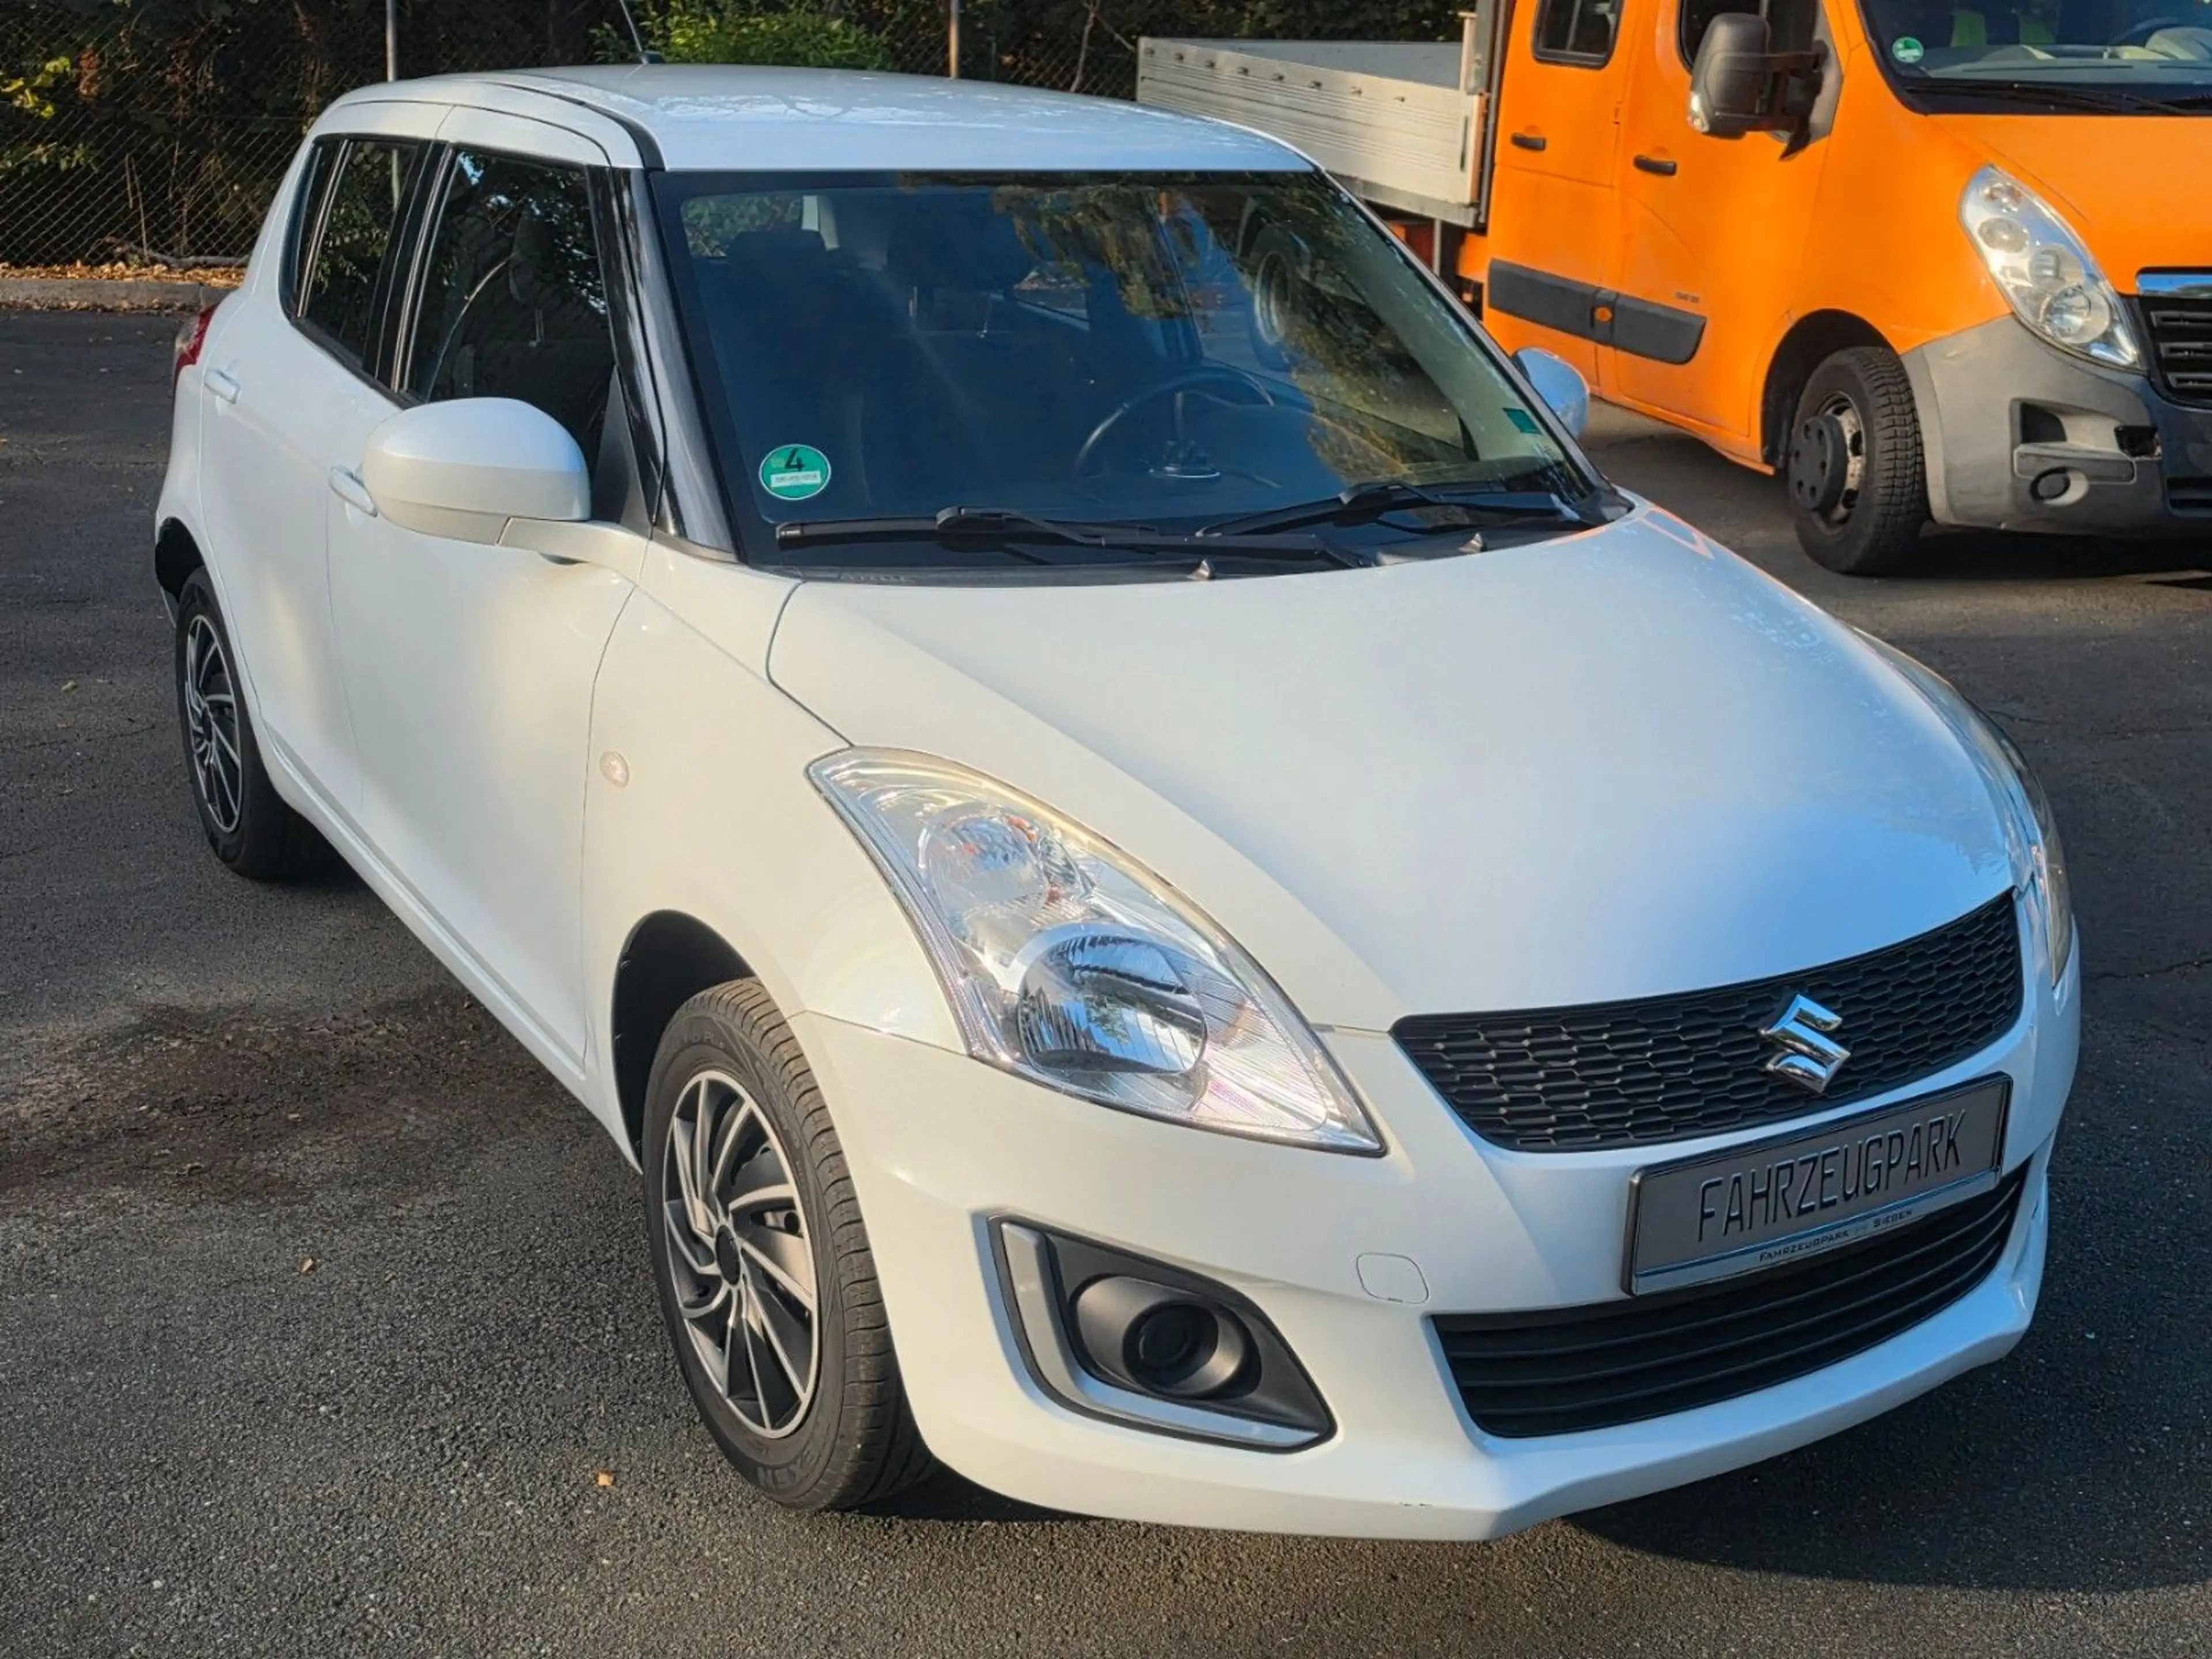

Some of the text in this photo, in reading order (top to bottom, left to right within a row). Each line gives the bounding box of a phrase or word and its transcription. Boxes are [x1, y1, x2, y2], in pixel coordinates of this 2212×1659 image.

[785, 448, 805, 472] 4
[1698, 1109, 1965, 1242] FAHRZEUGPARK
[1759, 1230, 1849, 1262] FAHRZEUGPARK
